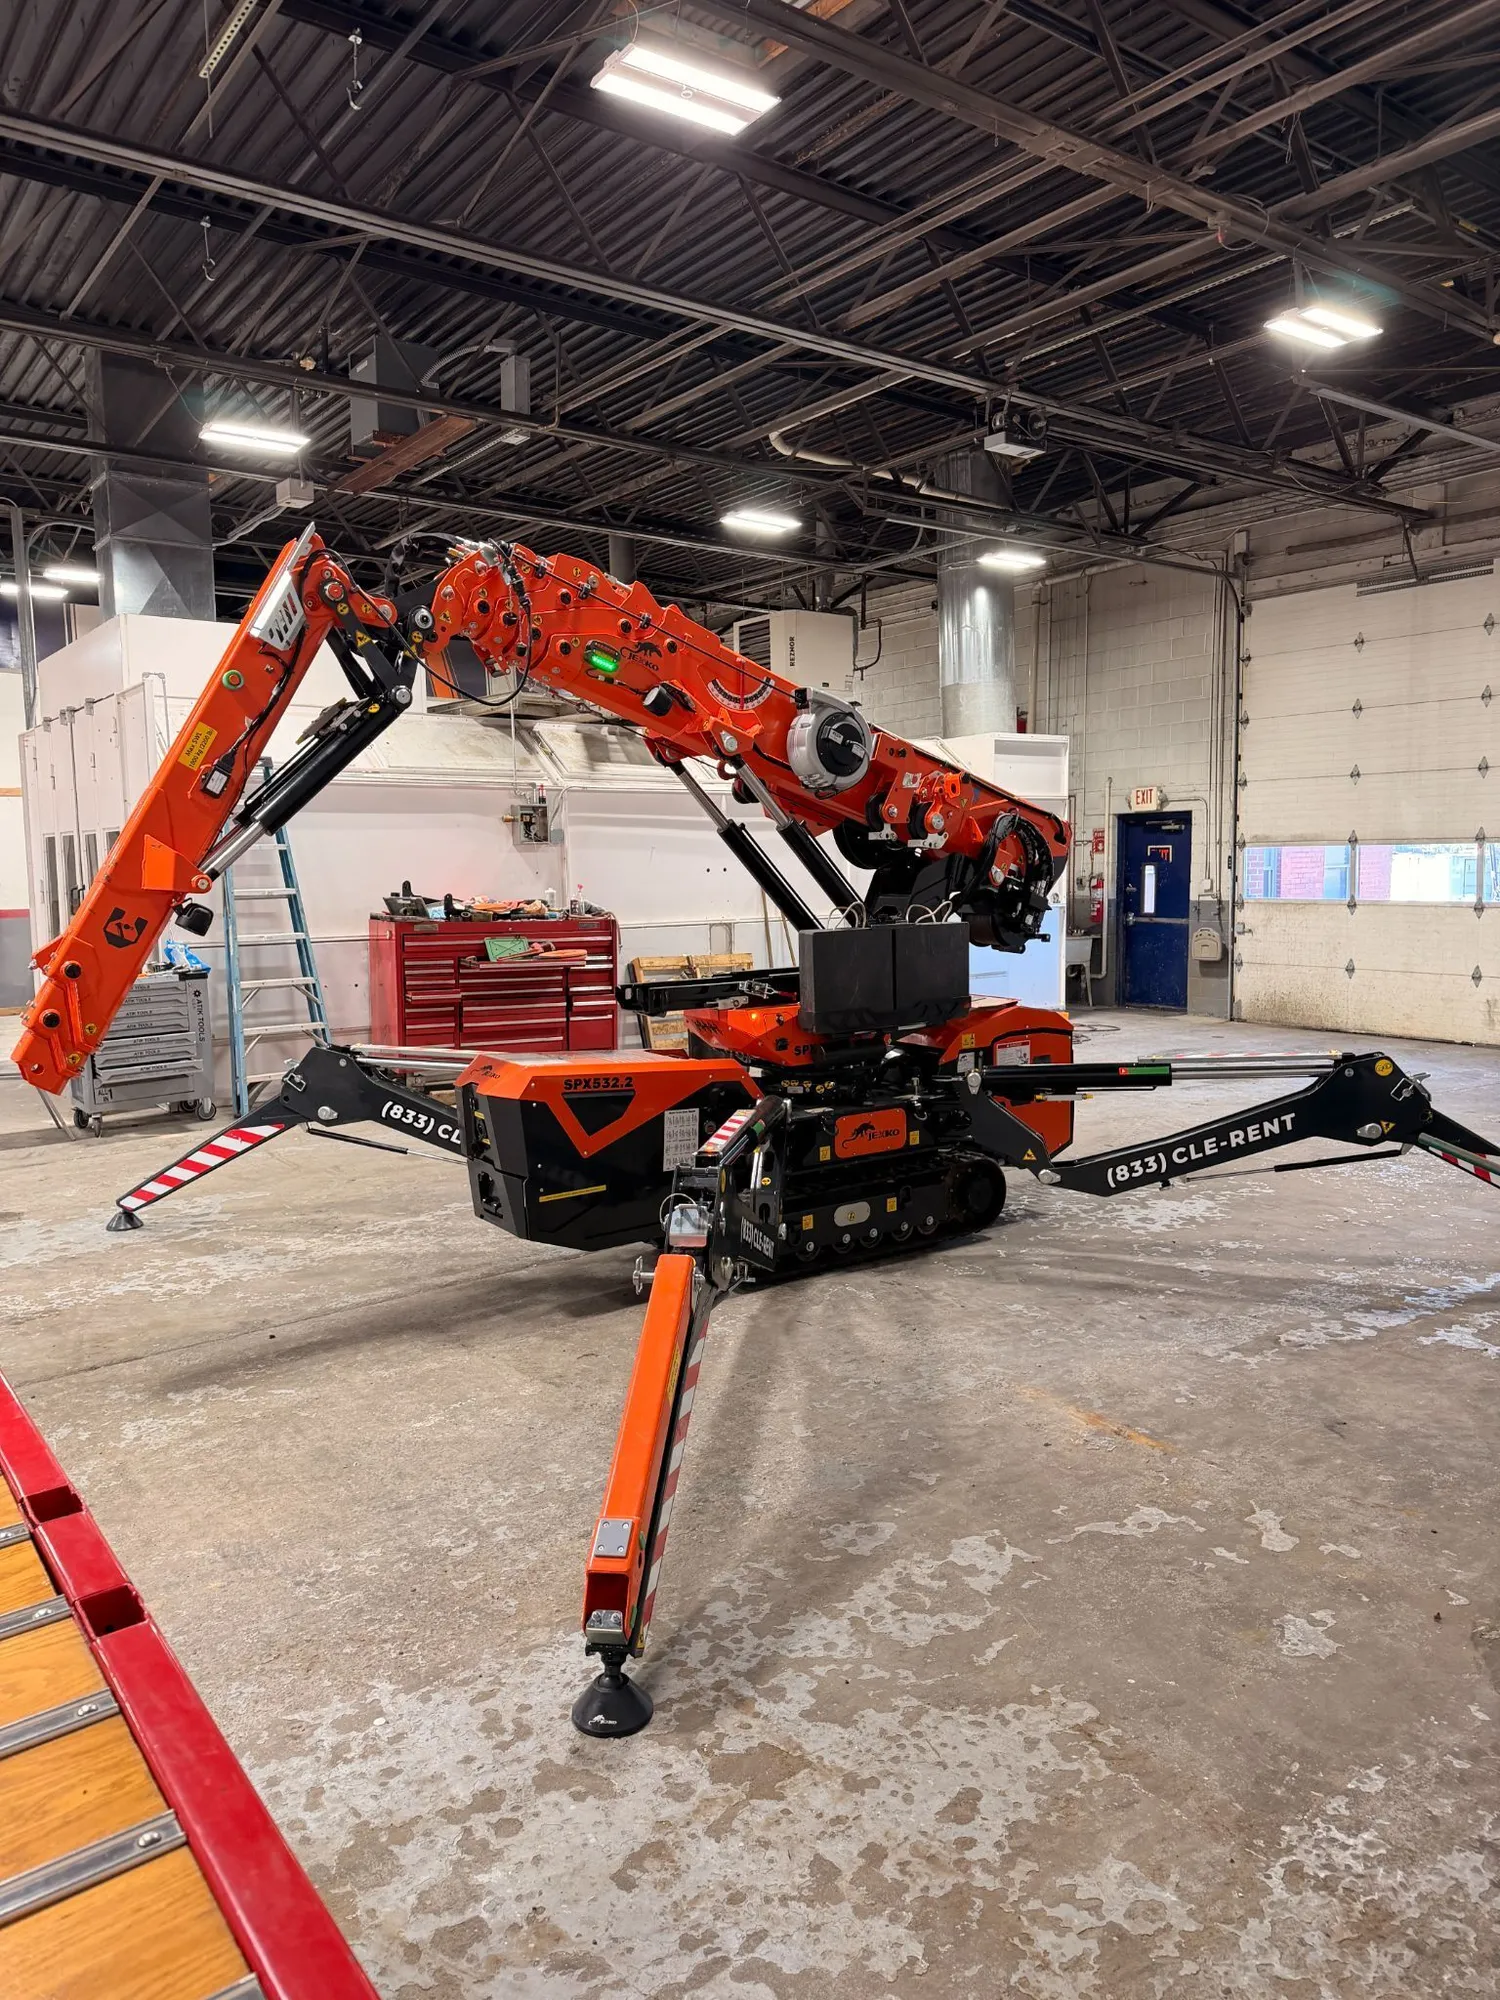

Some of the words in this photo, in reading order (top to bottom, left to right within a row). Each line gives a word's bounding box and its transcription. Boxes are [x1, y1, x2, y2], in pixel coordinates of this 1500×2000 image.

[185, 744, 196, 757] Max
[192, 732, 203, 746] SWL
[195, 748, 204, 758] kg
[1135, 788, 1154, 805] EXIT
[196, 998, 204, 1016] ATIK
[197, 1017, 206, 1042] TOOLS
[563, 1077, 634, 1091] SPX532.2
[381, 1101, 435, 1135] (833)
[1106, 1152, 1167, 1189] (833)
[1172, 1112, 1296, 1165] CLE-RENT
[740, 1216, 754, 1250] (833)
[753, 1227, 775, 1260] CLE-RENT
